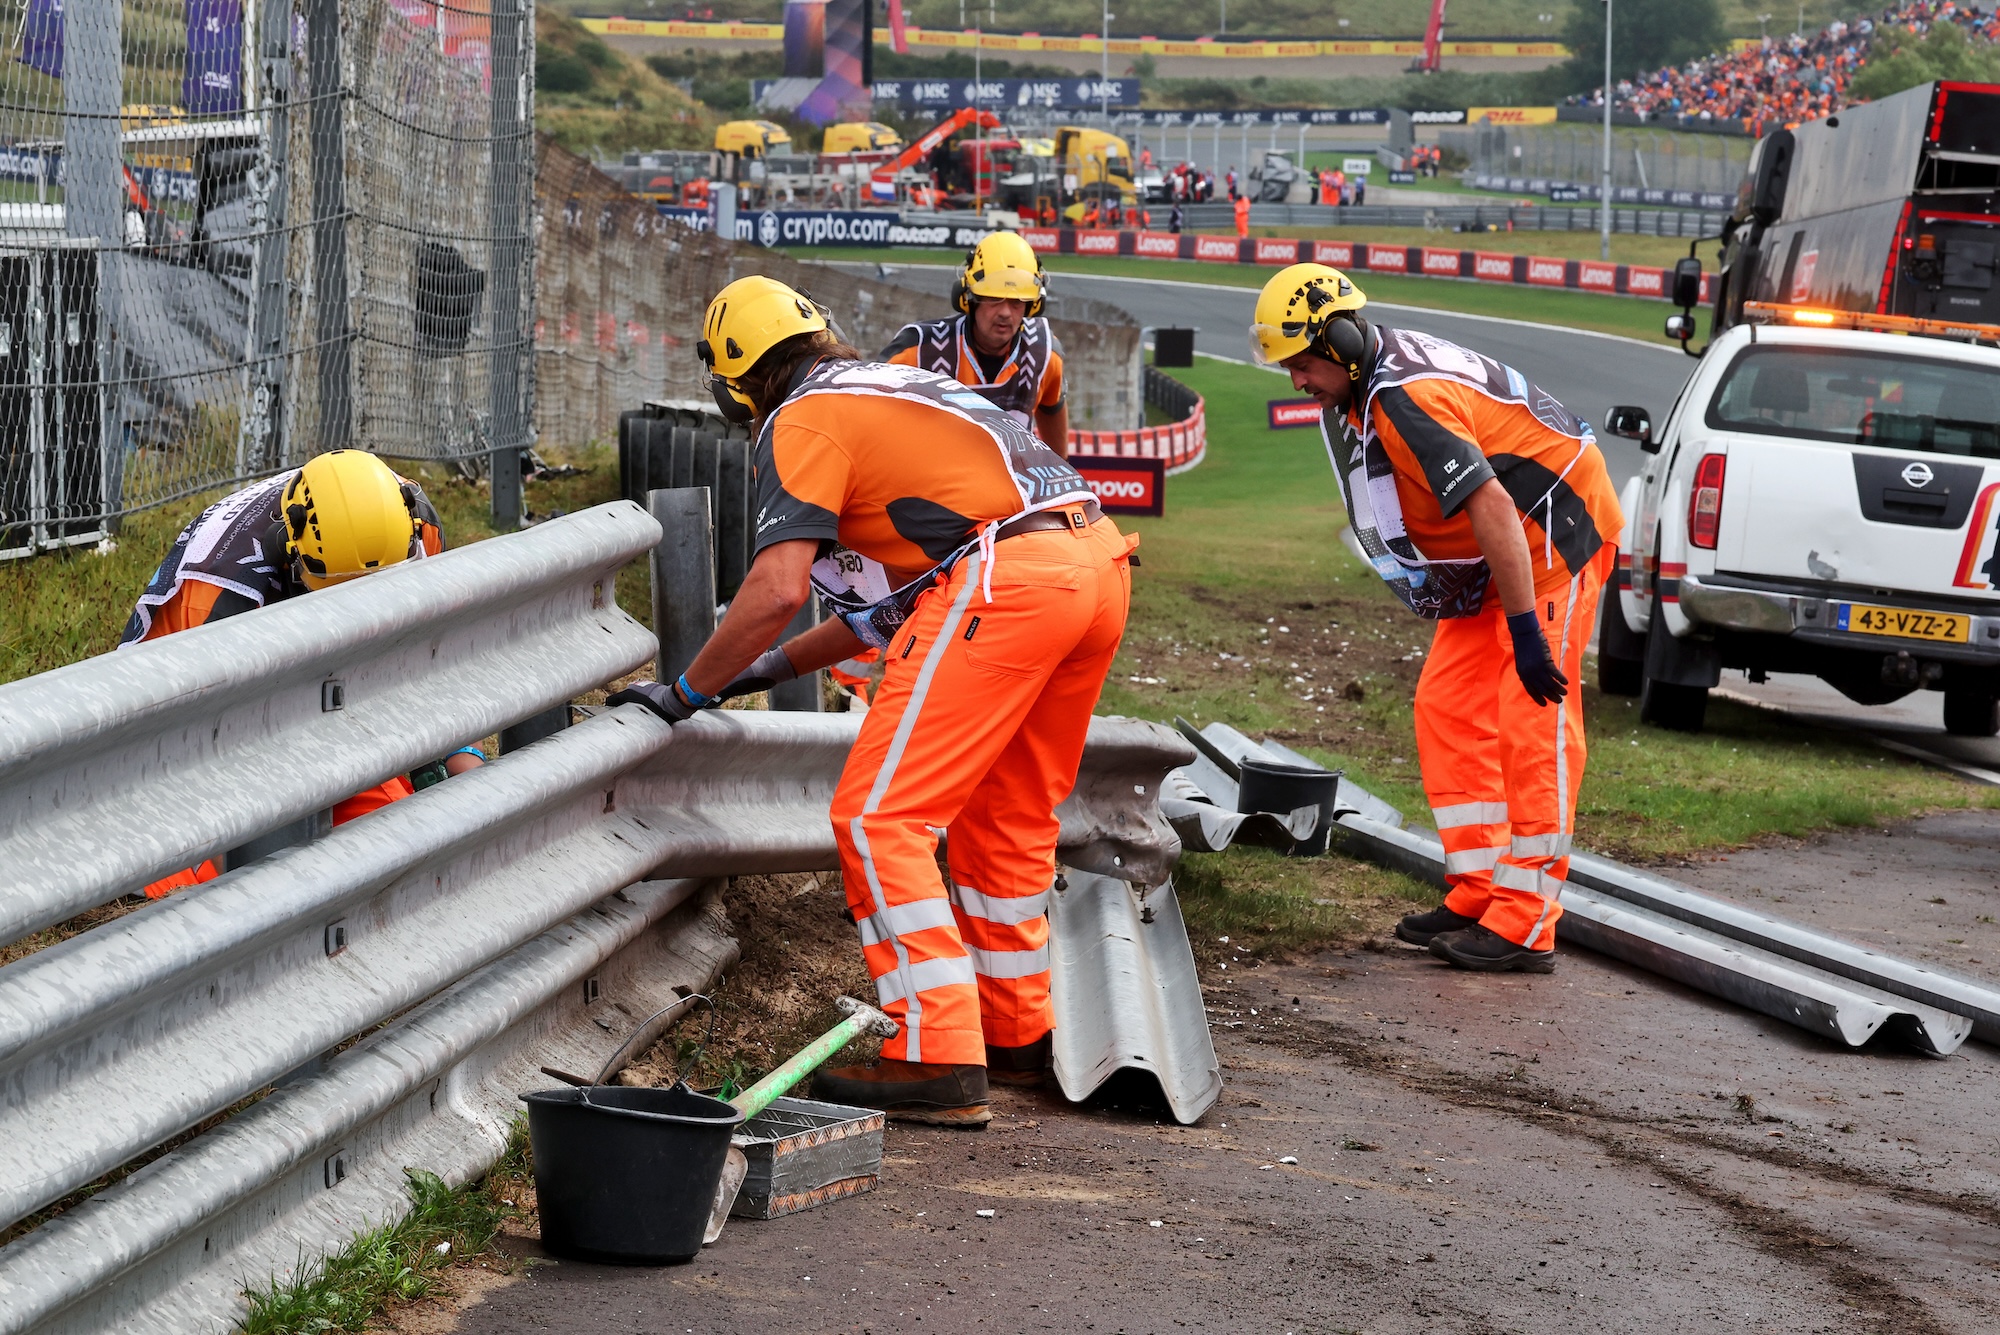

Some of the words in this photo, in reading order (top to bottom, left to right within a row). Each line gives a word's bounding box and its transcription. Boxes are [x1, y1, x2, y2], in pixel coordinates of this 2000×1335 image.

[876, 83, 900, 98] MSC
[923, 83, 950, 98] MSC
[978, 83, 1005, 98] MSC
[1033, 83, 1061, 98] MSC
[1092, 82, 1122, 97] MSC
[783, 213, 889, 244] crypto.com
[1078, 232, 1116, 250] Lenovo
[1137, 234, 1175, 253] Lenovo
[1198, 236, 1236, 255] Lenovo
[1258, 239, 1295, 259] Lenovo
[1316, 244, 1350, 262] Lenovo
[1369, 246, 1404, 267] Lenovo
[1424, 250, 1458, 270] Lenovo
[1477, 254, 1511, 275] Lenovo
[1530, 259, 1563, 279] Lenovo
[1581, 265, 1613, 286] Lenovo
[1630, 269, 1661, 290] Lenovo
[1277, 408, 1321, 421] Lenovo
[1088, 480, 1144, 498] novo
[215, 503, 260, 560] Championship
[1860, 610, 1957, 637] 43-VZZ-2
